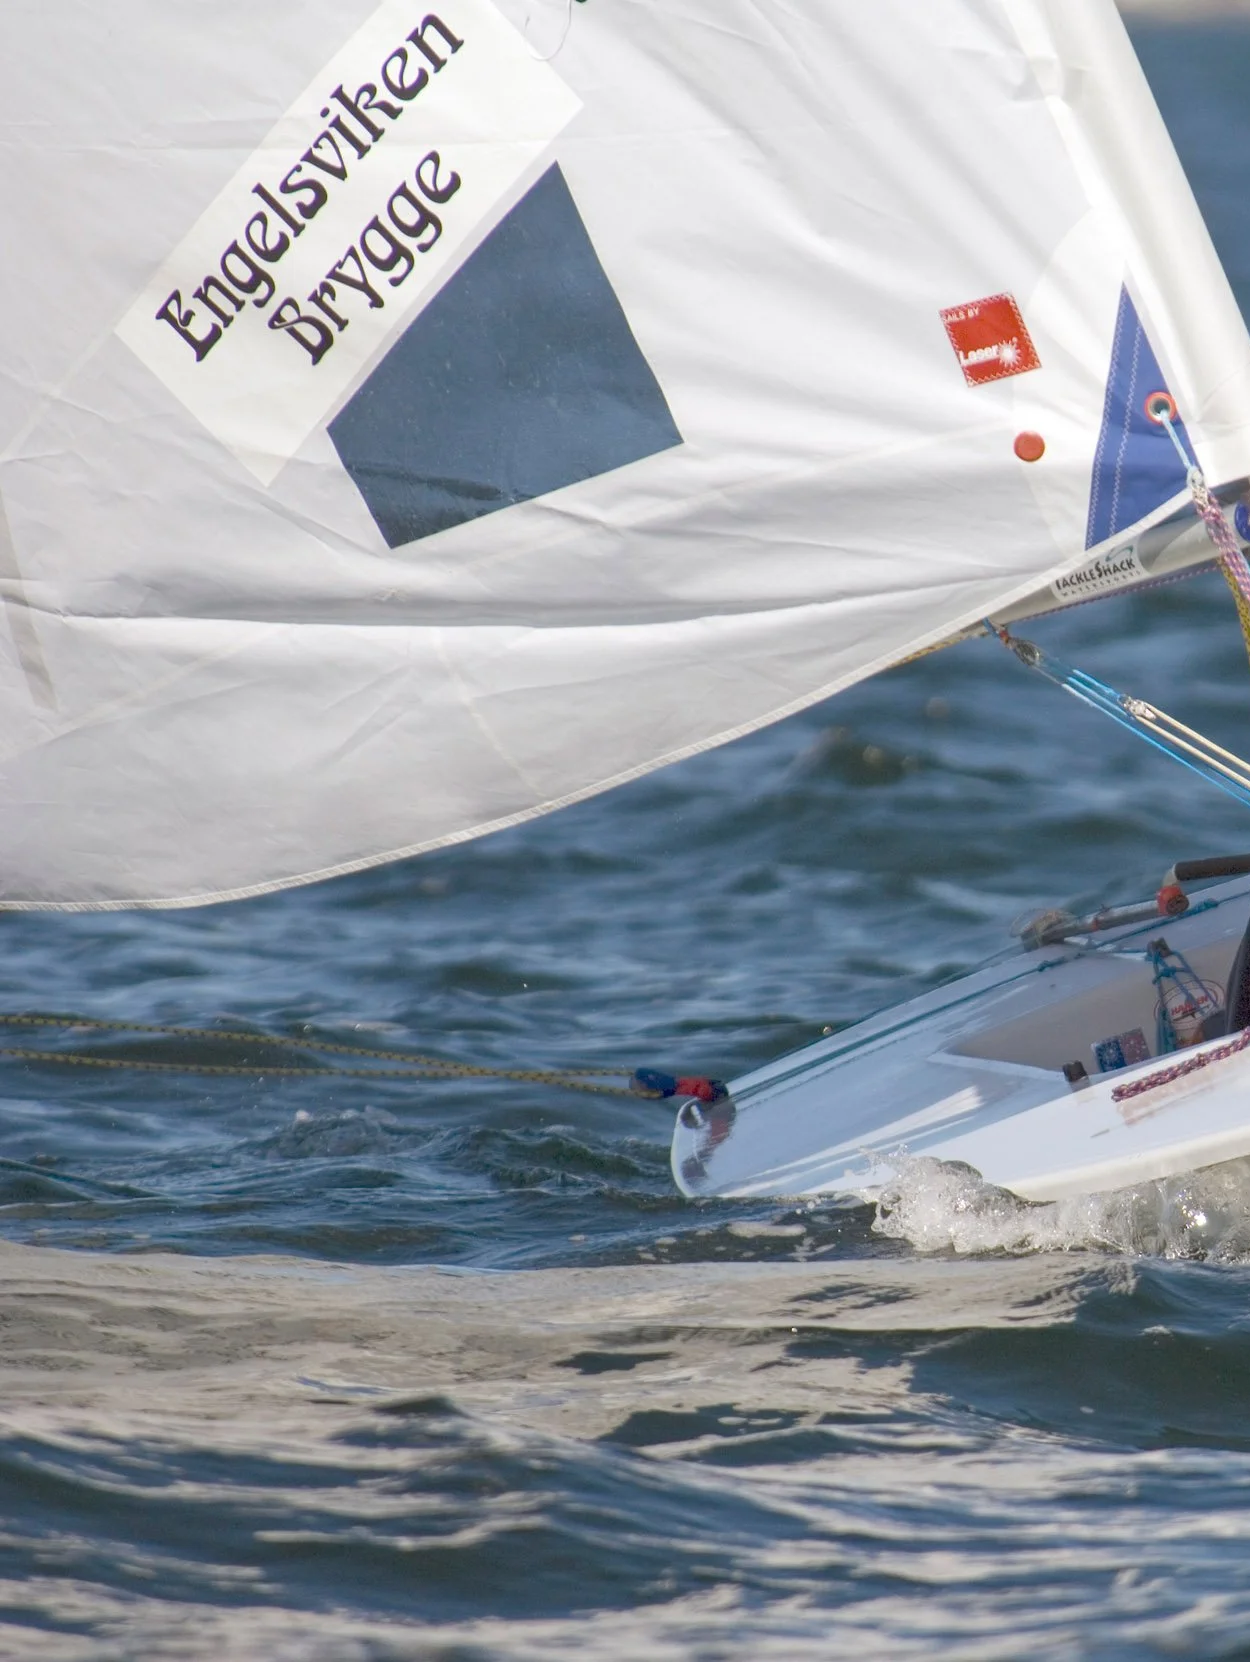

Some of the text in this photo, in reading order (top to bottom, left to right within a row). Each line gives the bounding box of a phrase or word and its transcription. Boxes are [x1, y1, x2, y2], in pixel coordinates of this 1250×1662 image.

[154, 13, 465, 362] Engelsviken
[267, 150, 462, 366] Brygge
[967, 306, 980, 319] BY
[960, 344, 999, 367] Laser
